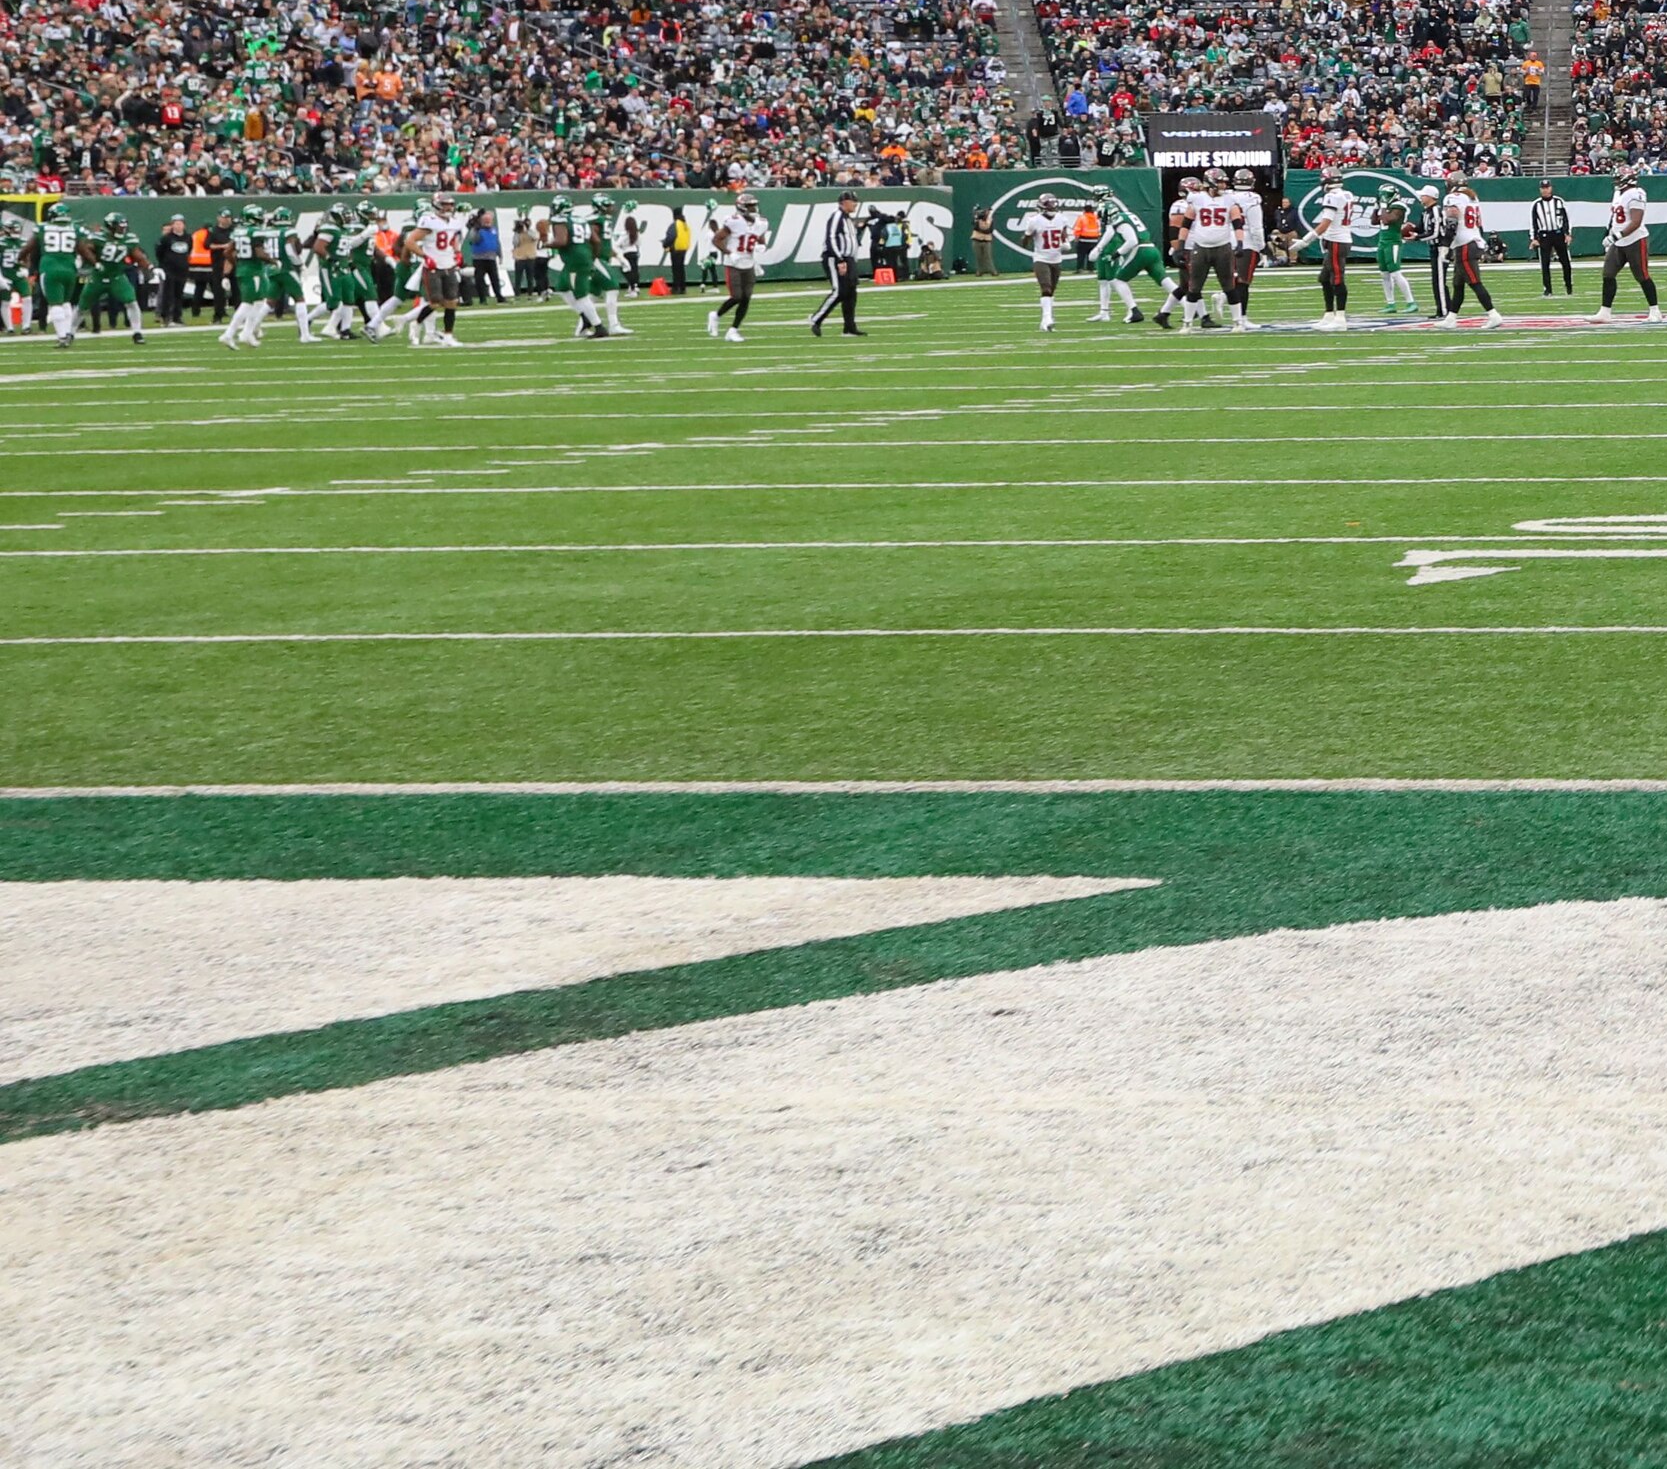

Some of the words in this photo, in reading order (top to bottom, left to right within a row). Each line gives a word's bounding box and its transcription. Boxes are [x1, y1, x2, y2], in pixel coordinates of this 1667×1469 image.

[1161, 129, 1253, 139] verizon
[1155, 150, 1218, 168] METLIFE
[1220, 149, 1272, 168] STADIUM
[1199, 207, 1227, 227] 65
[44, 232, 77, 253] 96
[1041, 229, 1063, 250] 15
[101, 242, 128, 263] 97
